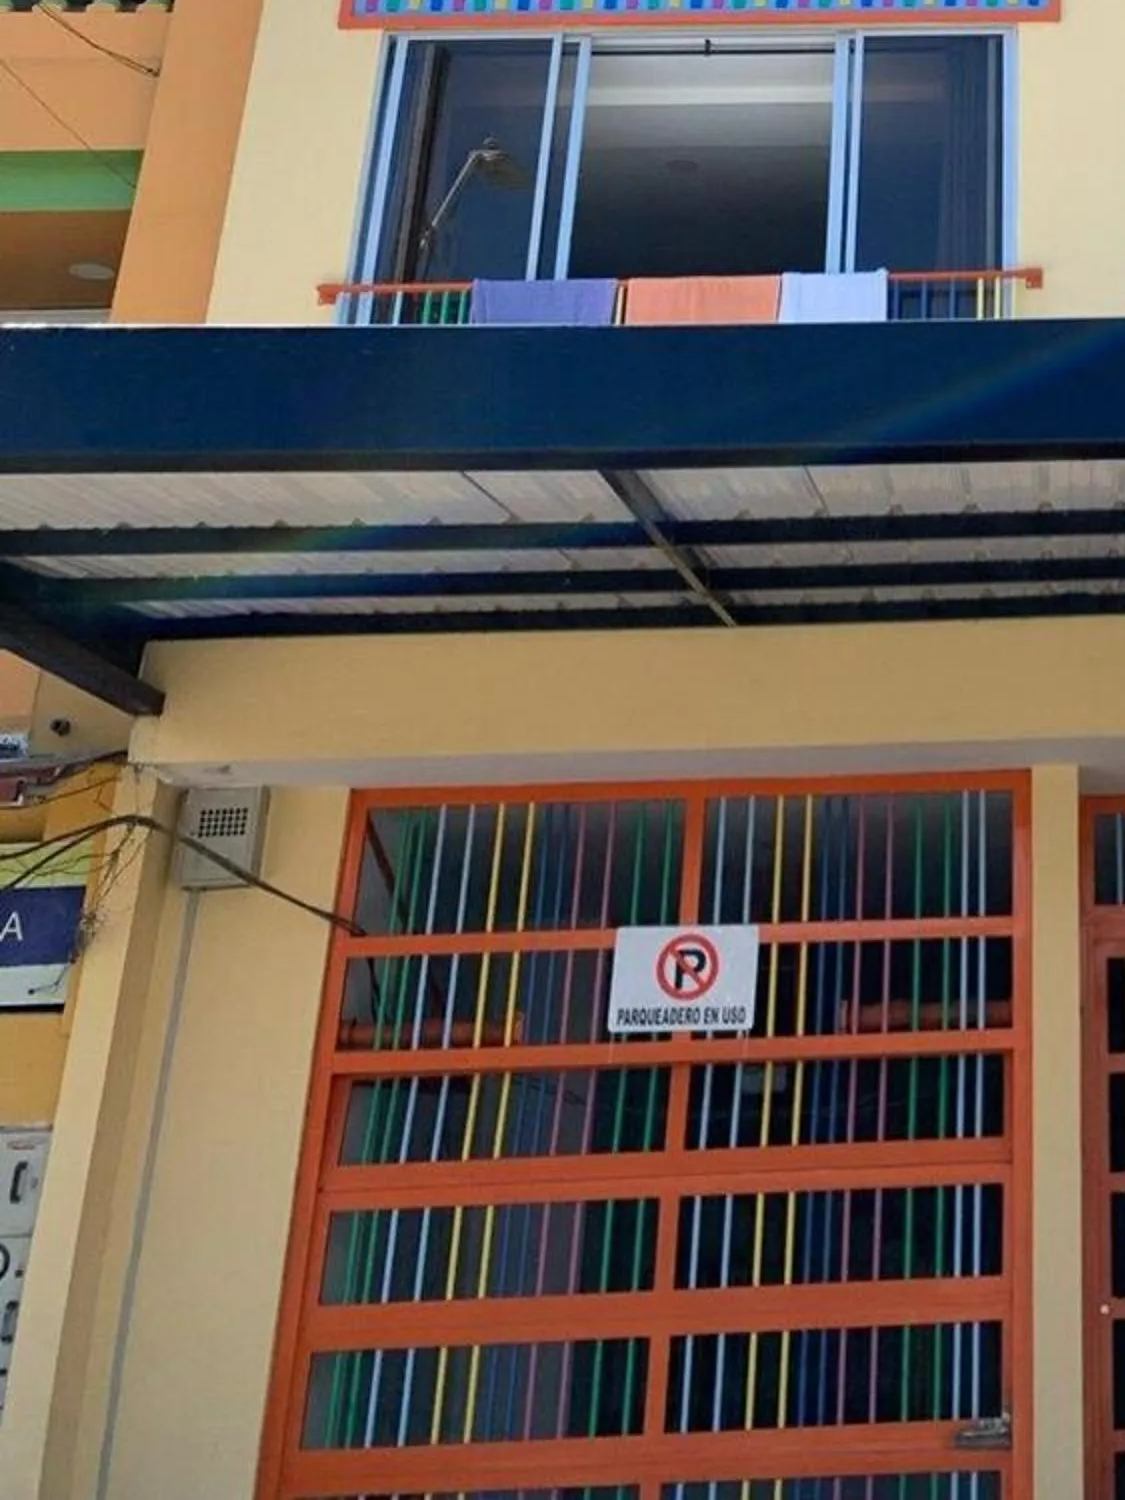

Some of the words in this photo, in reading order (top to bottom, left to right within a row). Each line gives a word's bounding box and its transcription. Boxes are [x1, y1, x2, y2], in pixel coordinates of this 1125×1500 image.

[617, 1006, 701, 1026] PARQUEADERO
[703, 1006, 719, 1025] EN
[722, 1006, 746, 1025] USO
